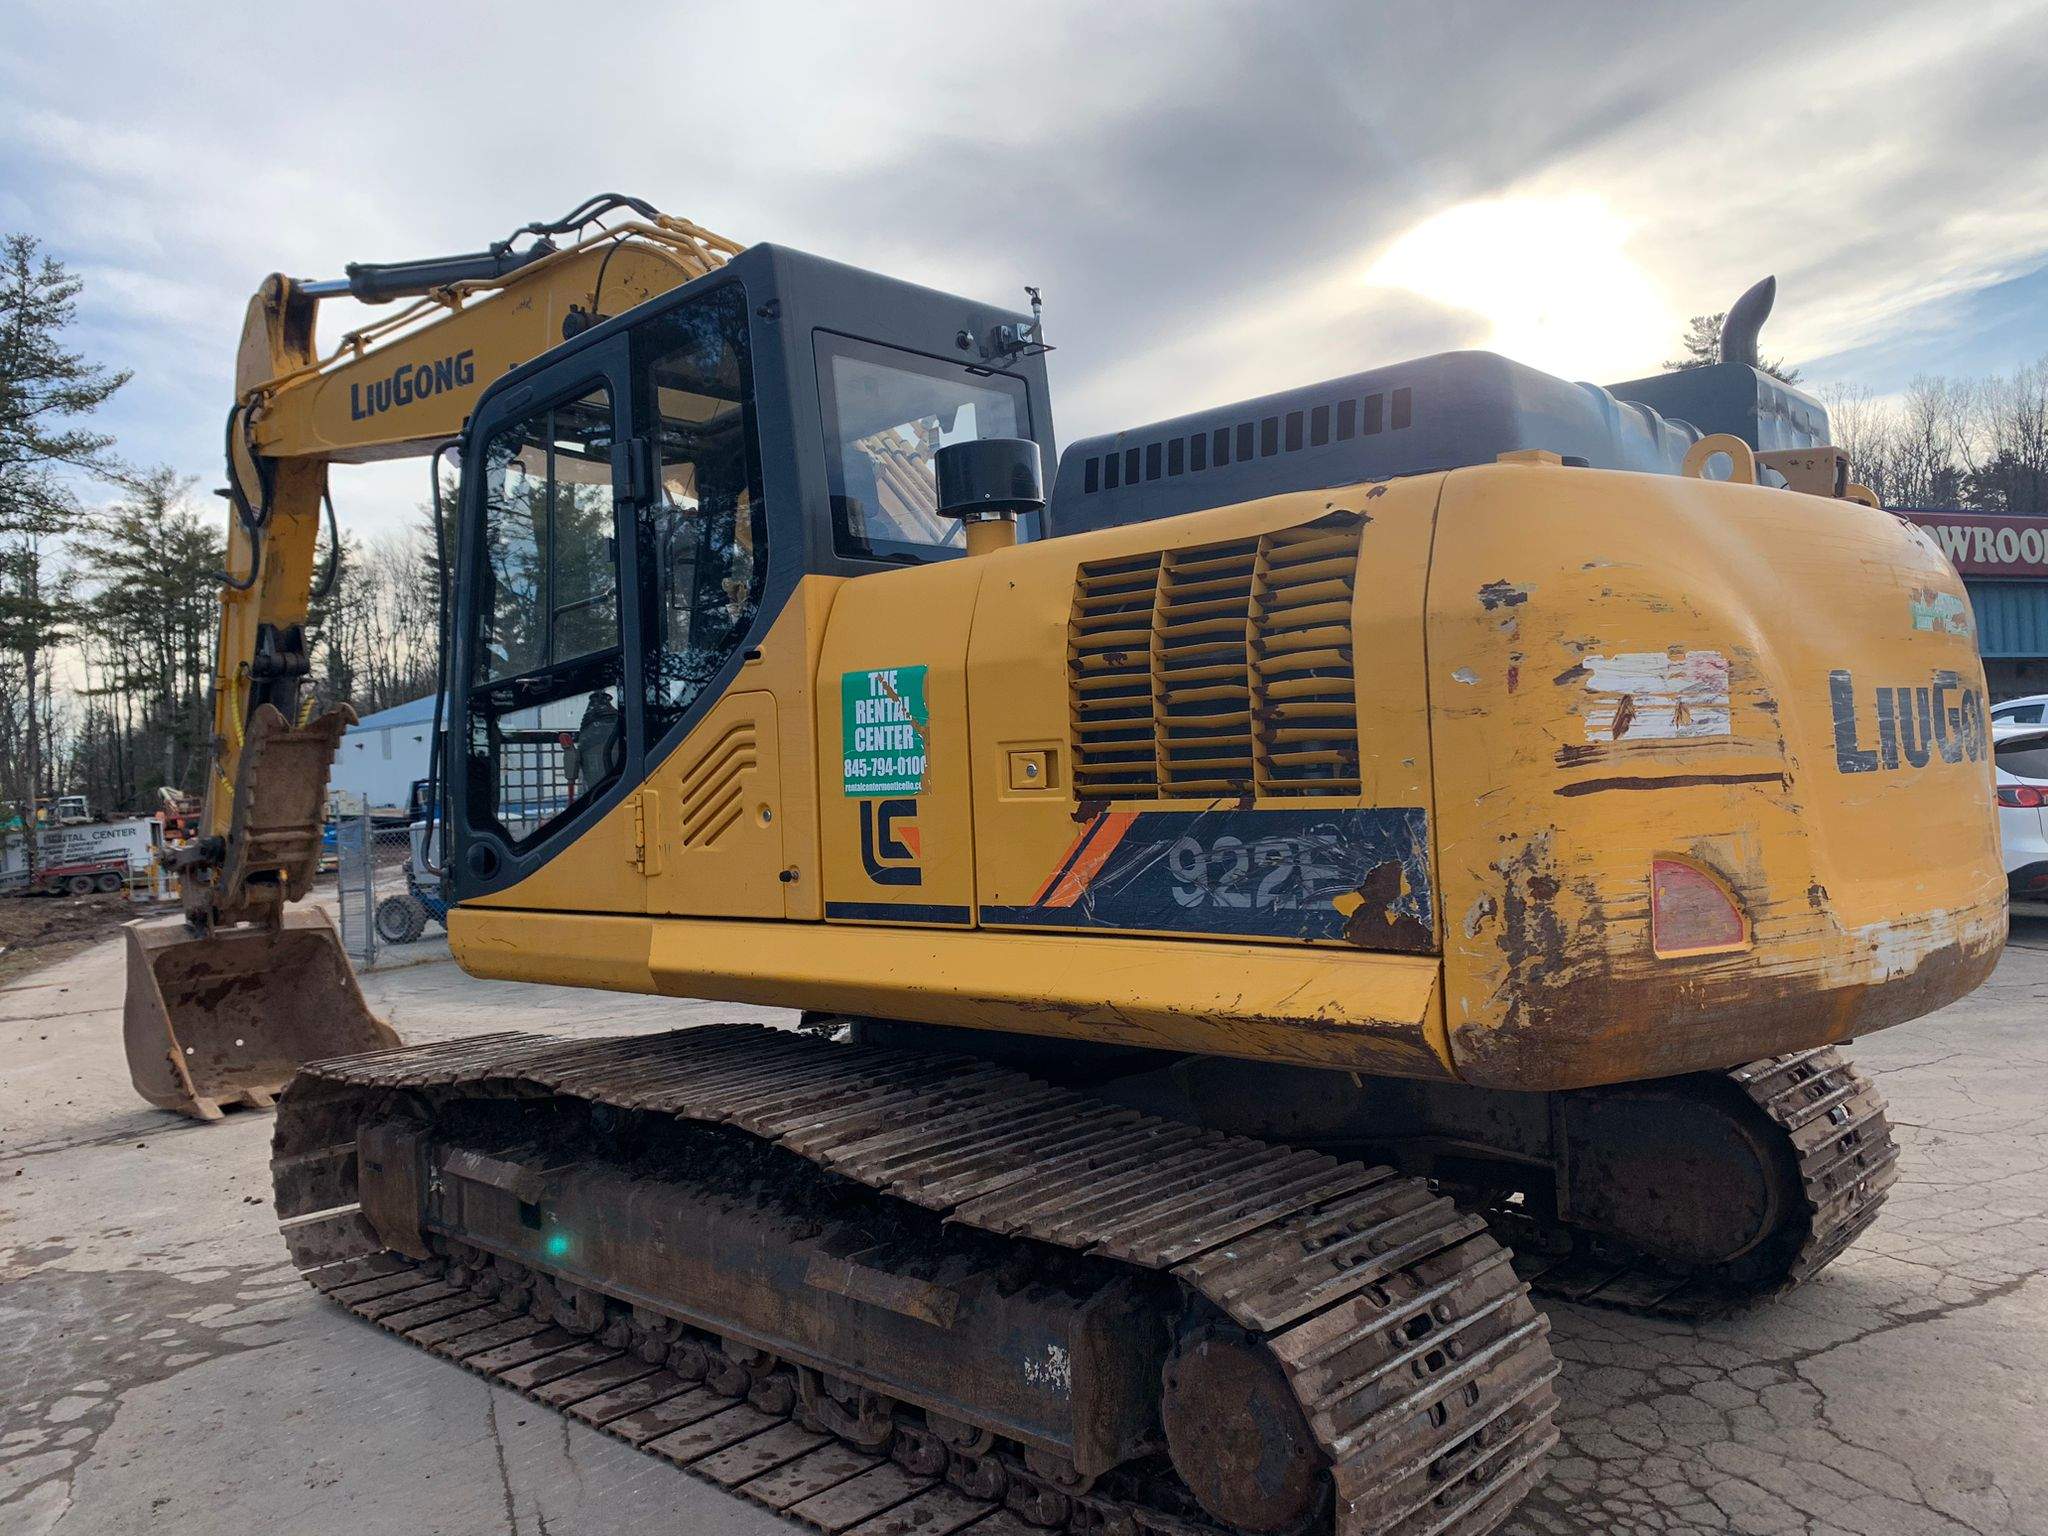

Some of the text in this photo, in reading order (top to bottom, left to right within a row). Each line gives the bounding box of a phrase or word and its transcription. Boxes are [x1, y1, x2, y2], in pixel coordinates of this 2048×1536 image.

[868, 670, 898, 697] THE
[855, 696, 912, 725] RENTAL
[854, 724, 914, 752] CENTER
[92, 828, 136, 840] CENTER
